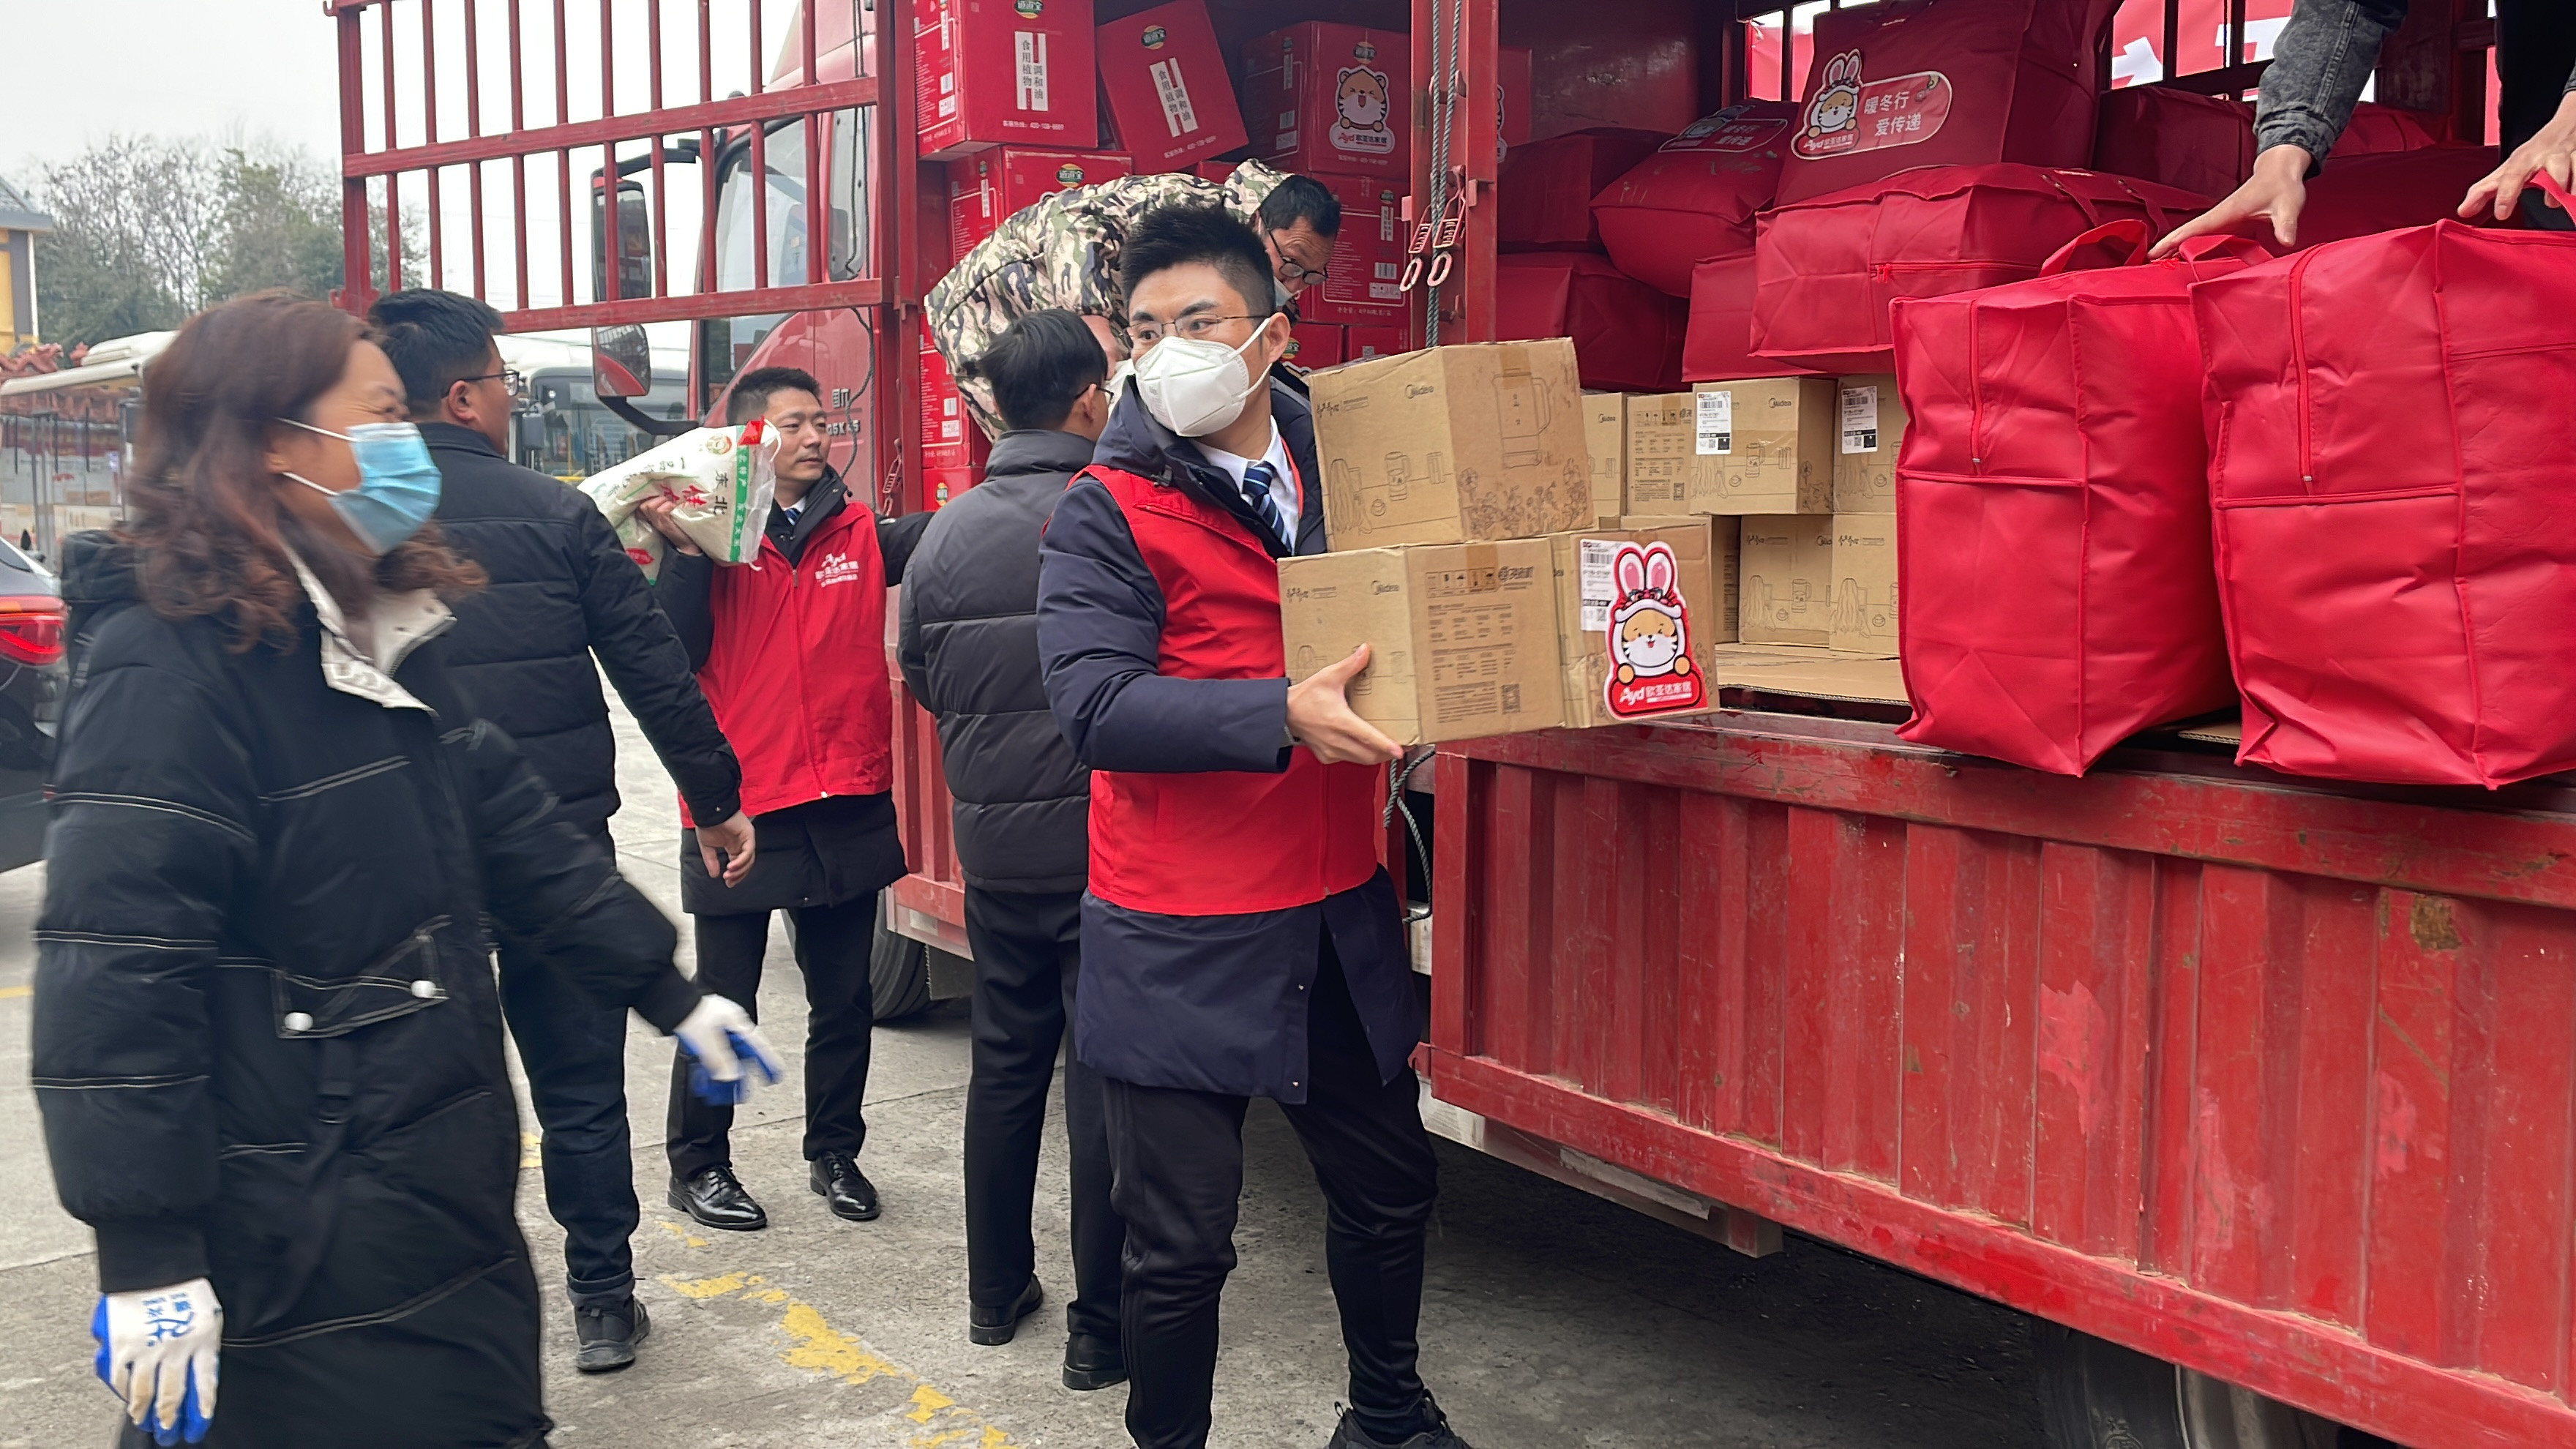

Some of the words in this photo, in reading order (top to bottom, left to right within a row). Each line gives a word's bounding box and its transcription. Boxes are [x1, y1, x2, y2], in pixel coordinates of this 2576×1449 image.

[1022, 40, 1033, 86] 食用植物
[1033, 64, 1044, 100] 调和油
[1158, 70, 1178, 113] 食用植物
[1864, 91, 1911, 114] 暖冬行
[1875, 112, 1922, 137] 爱传递
[1803, 139, 1824, 151] Ayd
[1405, 383, 1434, 399] Midea
[1769, 397, 1791, 408] Midea
[1598, 413, 1616, 423] Midea
[714, 469, 729, 515] 东北
[1371, 580, 1399, 595] Midea
[1620, 686, 1645, 705] Ayd
